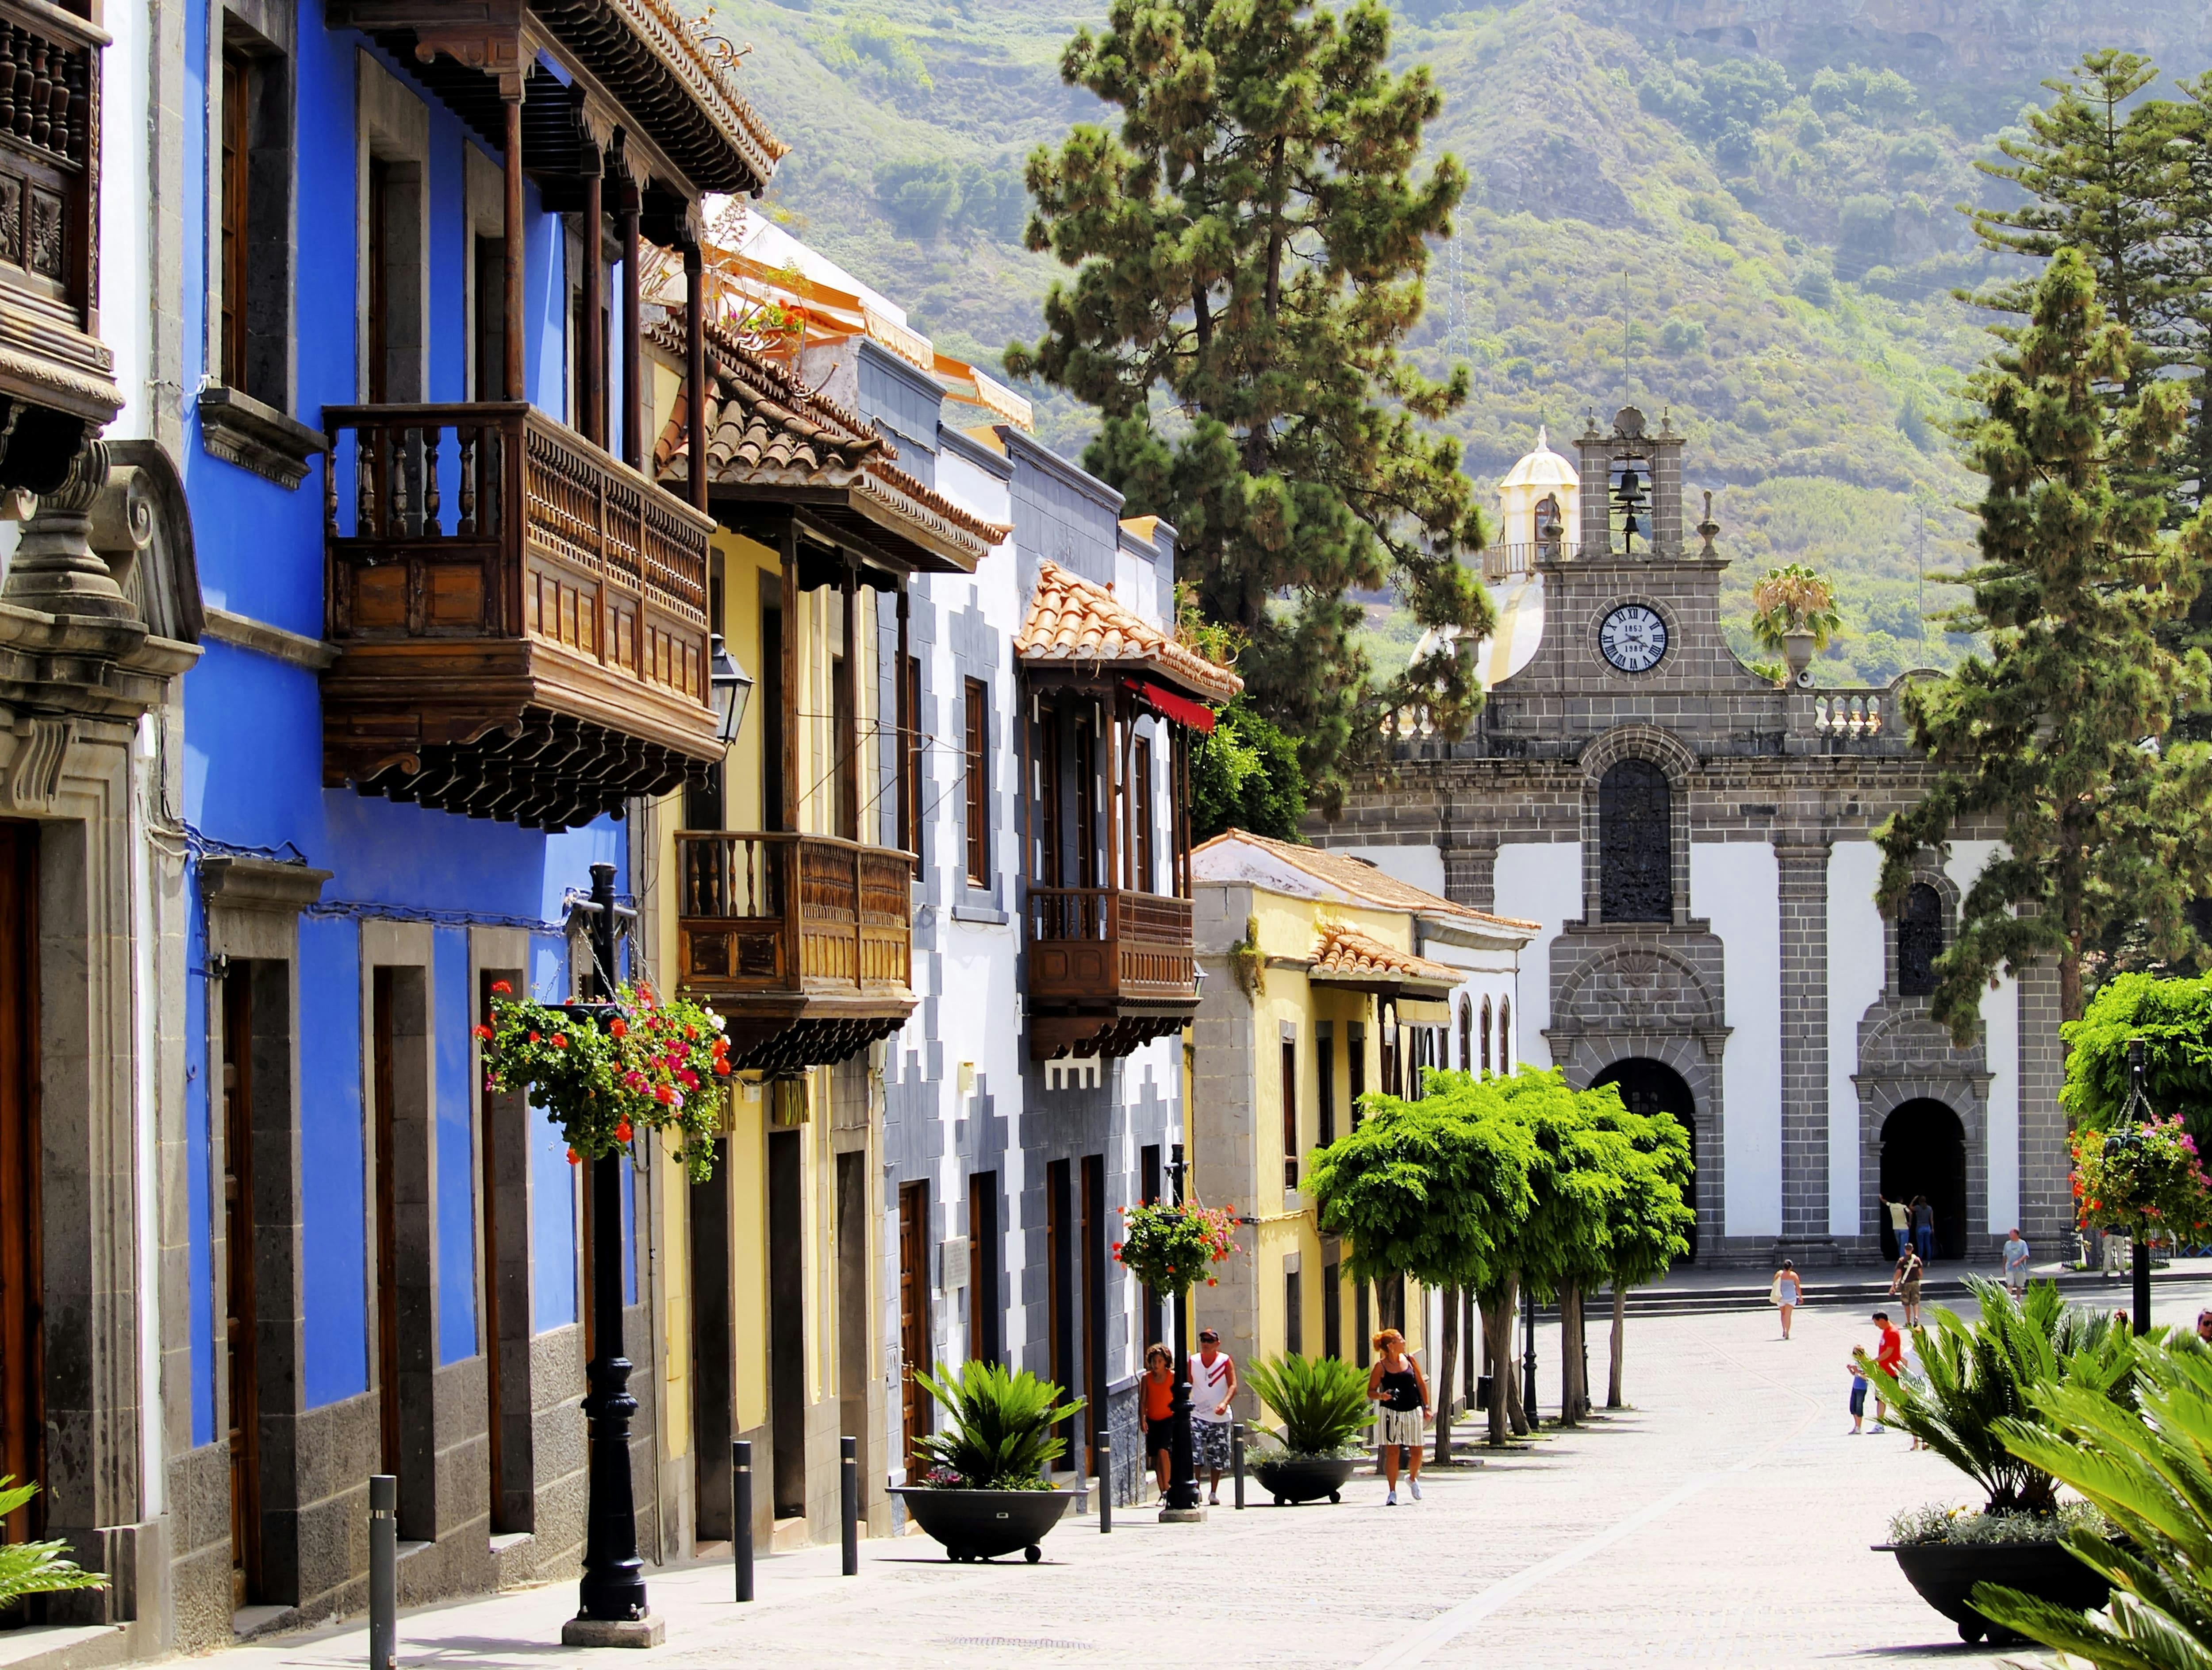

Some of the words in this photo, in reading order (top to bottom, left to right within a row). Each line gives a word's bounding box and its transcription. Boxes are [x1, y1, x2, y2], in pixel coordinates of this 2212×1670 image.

[1614, 611, 1626, 623] XI
[1628, 608, 1638, 619] XII
[1642, 612, 1649, 622] I
[1606, 622, 1617, 631] X
[1649, 621, 1660, 630] II
[1603, 635, 1613, 643] IX
[1605, 644, 1618, 659] VIII
[1648, 645, 1662, 657] IIII
[1615, 654, 1626, 666] VII
[1643, 655, 1652, 666] V
[785, 1080, 810, 1126] BBVA
